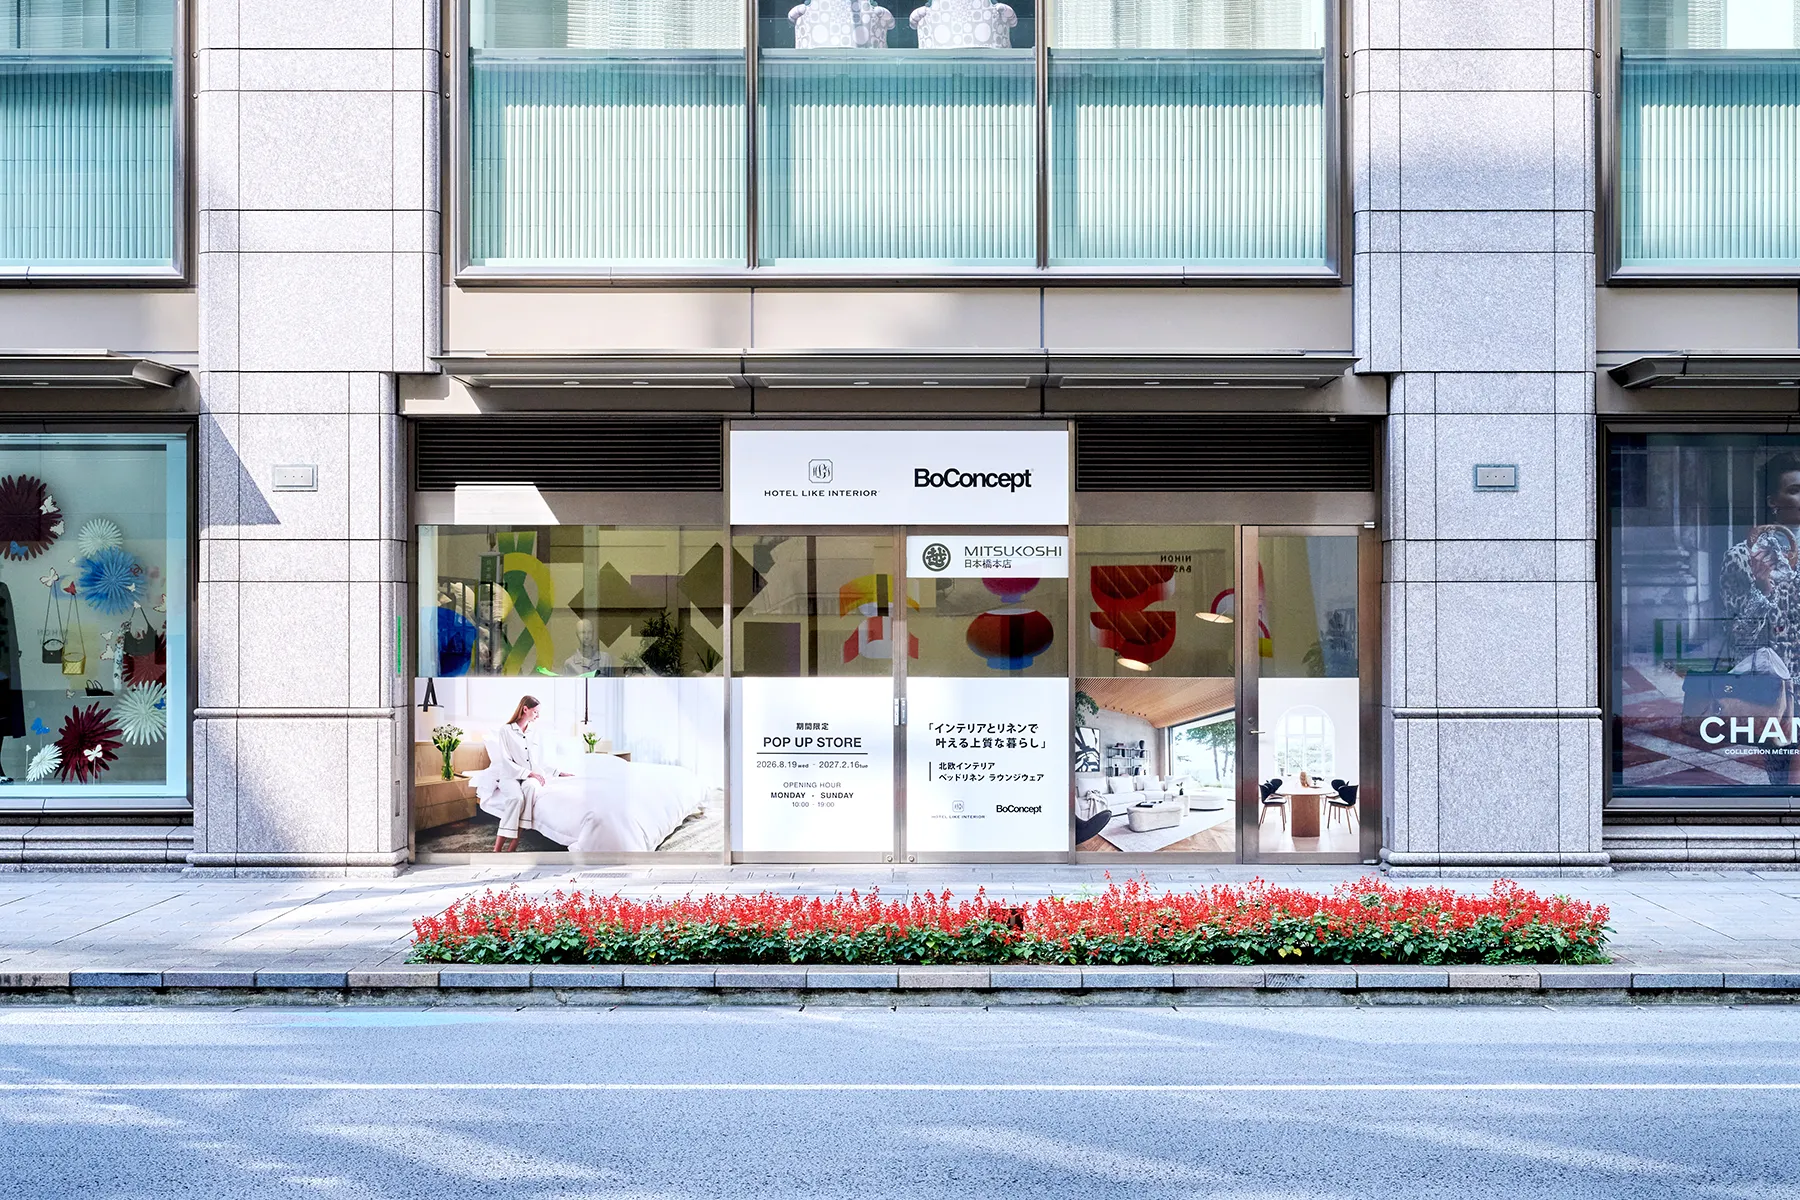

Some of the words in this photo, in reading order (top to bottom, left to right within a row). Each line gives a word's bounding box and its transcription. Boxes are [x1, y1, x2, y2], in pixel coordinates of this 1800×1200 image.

[914, 467, 1032, 493] BoConcept
[764, 489, 799, 497] HOTEL
[801, 489, 825, 497] LIKE
[828, 489, 877, 497] INTERIOR
[964, 545, 1062, 557] MITSUKOSHI
[964, 558, 1012, 569] 日本橋本店
[796, 722, 829, 731] 期間限定
[928, 722, 1040, 734] 「インテリアとリネンで
[763, 736, 792, 748] POP
[794, 736, 814, 748] UP
[816, 736, 862, 748] STORE
[935, 737, 1046, 749] 叶える上質な暮らし」
[938, 761, 996, 771] 北欧インテリア
[938, 773, 985, 782] ベッドリネン
[988, 773, 1045, 782] ラウンジウェア
[782, 781, 818, 789] OPENING
[819, 781, 842, 789] HOUR
[770, 791, 806, 799] MONDAY
[820, 791, 854, 799] SUNDAY
[995, 804, 1042, 815] BoConcept
